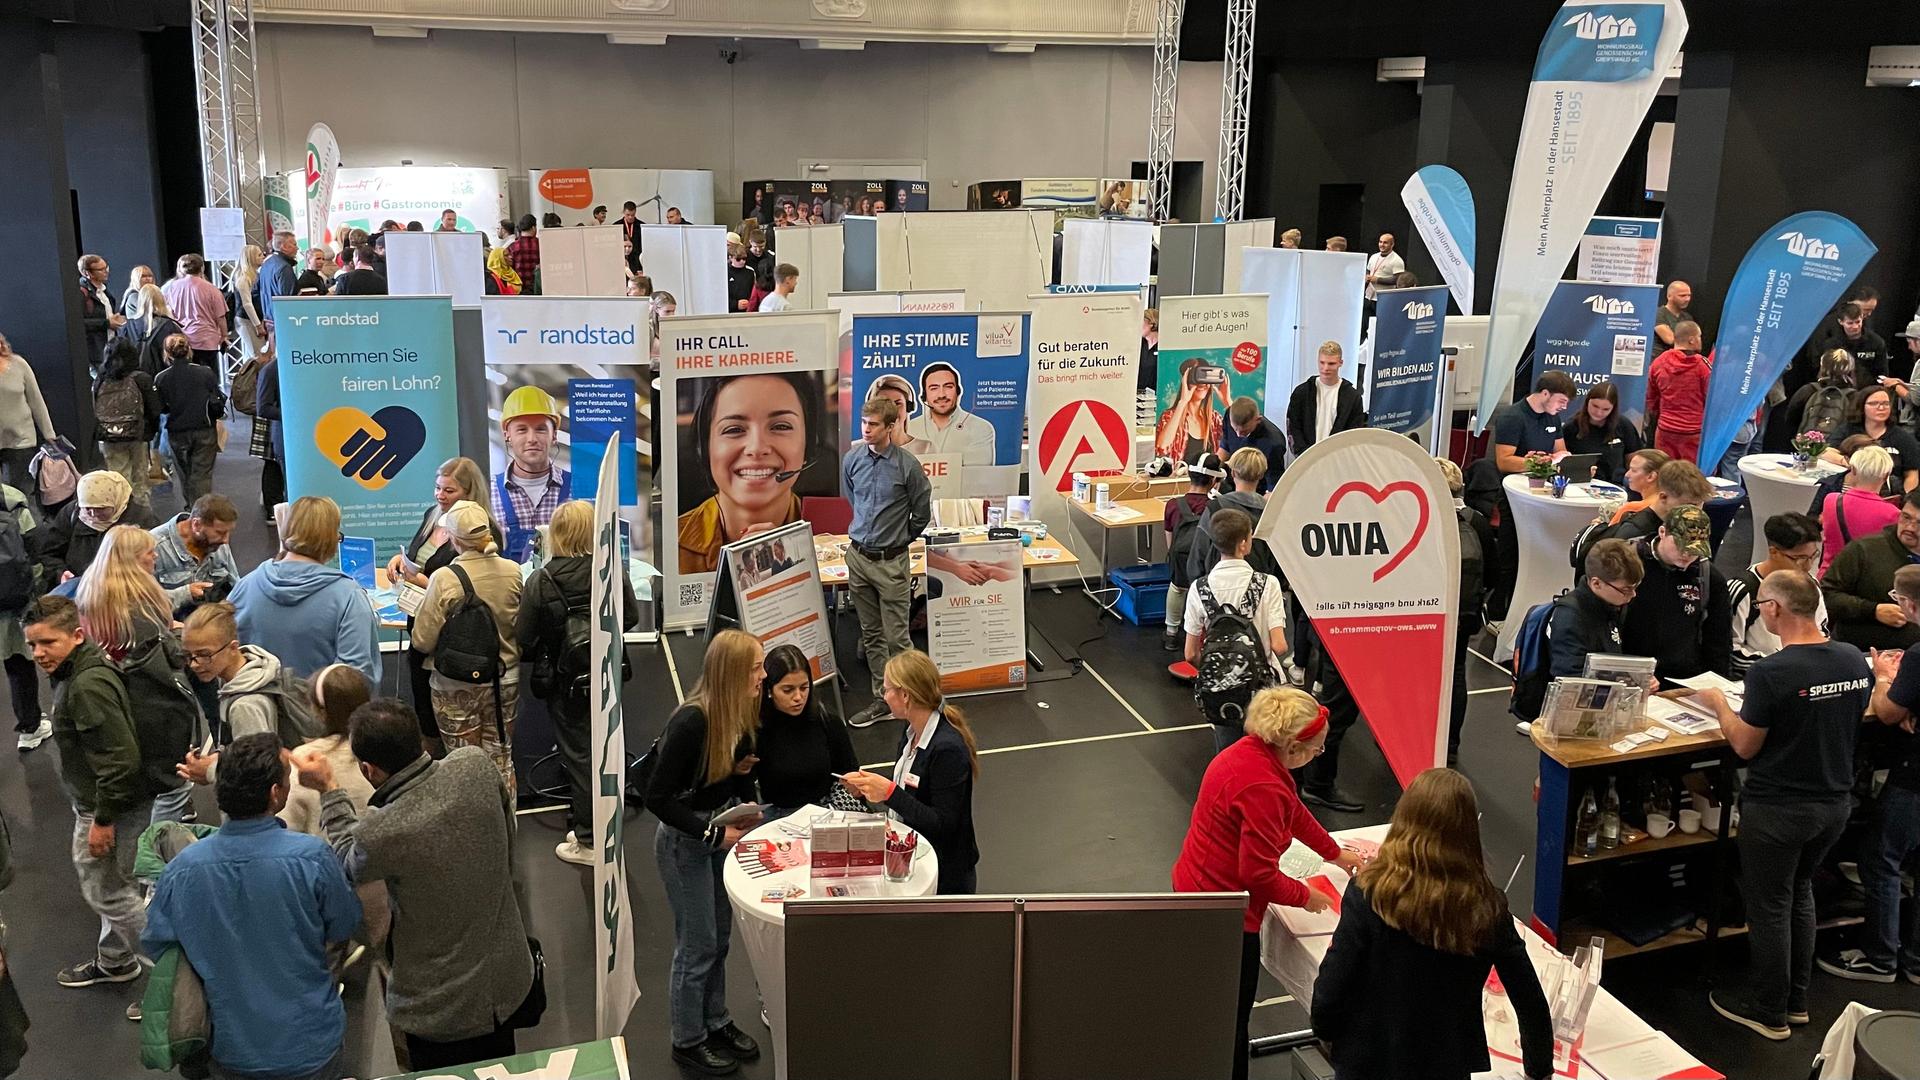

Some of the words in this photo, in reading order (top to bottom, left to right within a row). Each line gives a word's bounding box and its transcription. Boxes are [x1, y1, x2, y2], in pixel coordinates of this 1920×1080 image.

[1567, 91, 1584, 123] 1895
[1550, 90, 1564, 145] Hansestadt
[1549, 146, 1557, 164] der
[1562, 132, 1578, 165] SEIT
[1546, 165, 1555, 175] in
[373, 198, 462, 211] #Gastronomie
[1540, 178, 1554, 231] Ankerplatz
[1537, 231, 1548, 256] Mein
[1760, 269, 1776, 311] Hansestadt
[1775, 272, 1792, 298] 1895
[316, 312, 380, 326] randstad
[1182, 310, 1201, 320] Hier
[1232, 310, 1250, 318] was
[1756, 311, 1766, 325] der
[1768, 301, 1784, 329] SEIT
[540, 324, 635, 344] randstad
[1182, 324, 1197, 334] auf
[1200, 324, 1213, 332] die
[1215, 322, 1248, 334] Augen!
[676, 337, 704, 350] IHR
[708, 335, 749, 349] CALL.
[863, 334, 901, 348] IHRE
[905, 333, 969, 347] STIMME
[1038, 342, 1060, 354] Gut
[1064, 340, 1108, 352] beraten
[291, 349, 388, 365] Bekommen
[392, 348, 418, 363] Sie
[676, 355, 714, 369] IHRE
[719, 351, 799, 368] KARRIERE.
[862, 352, 916, 369] ZÄHLT!
[1038, 359, 1056, 370] für
[1059, 358, 1076, 369] die
[1080, 356, 1128, 368] Zukunft.
[1544, 354, 1581, 366] MEIN
[1744, 335, 1760, 376] Ankerplatz
[1038, 375, 1054, 384] Das
[1056, 374, 1078, 384] bringt
[1378, 368, 1390, 380] WIR
[1392, 364, 1418, 377] BILDEN
[1418, 362, 1434, 373] AUS
[342, 376, 388, 392] fairen
[392, 374, 442, 390] Lohn?
[1740, 374, 1752, 394] Mein
[922, 462, 948, 476] SIE
[950, 596, 970, 607] WIR
[988, 594, 1002, 604] SIE
[1810, 678, 1868, 696] SPEZITRANS
